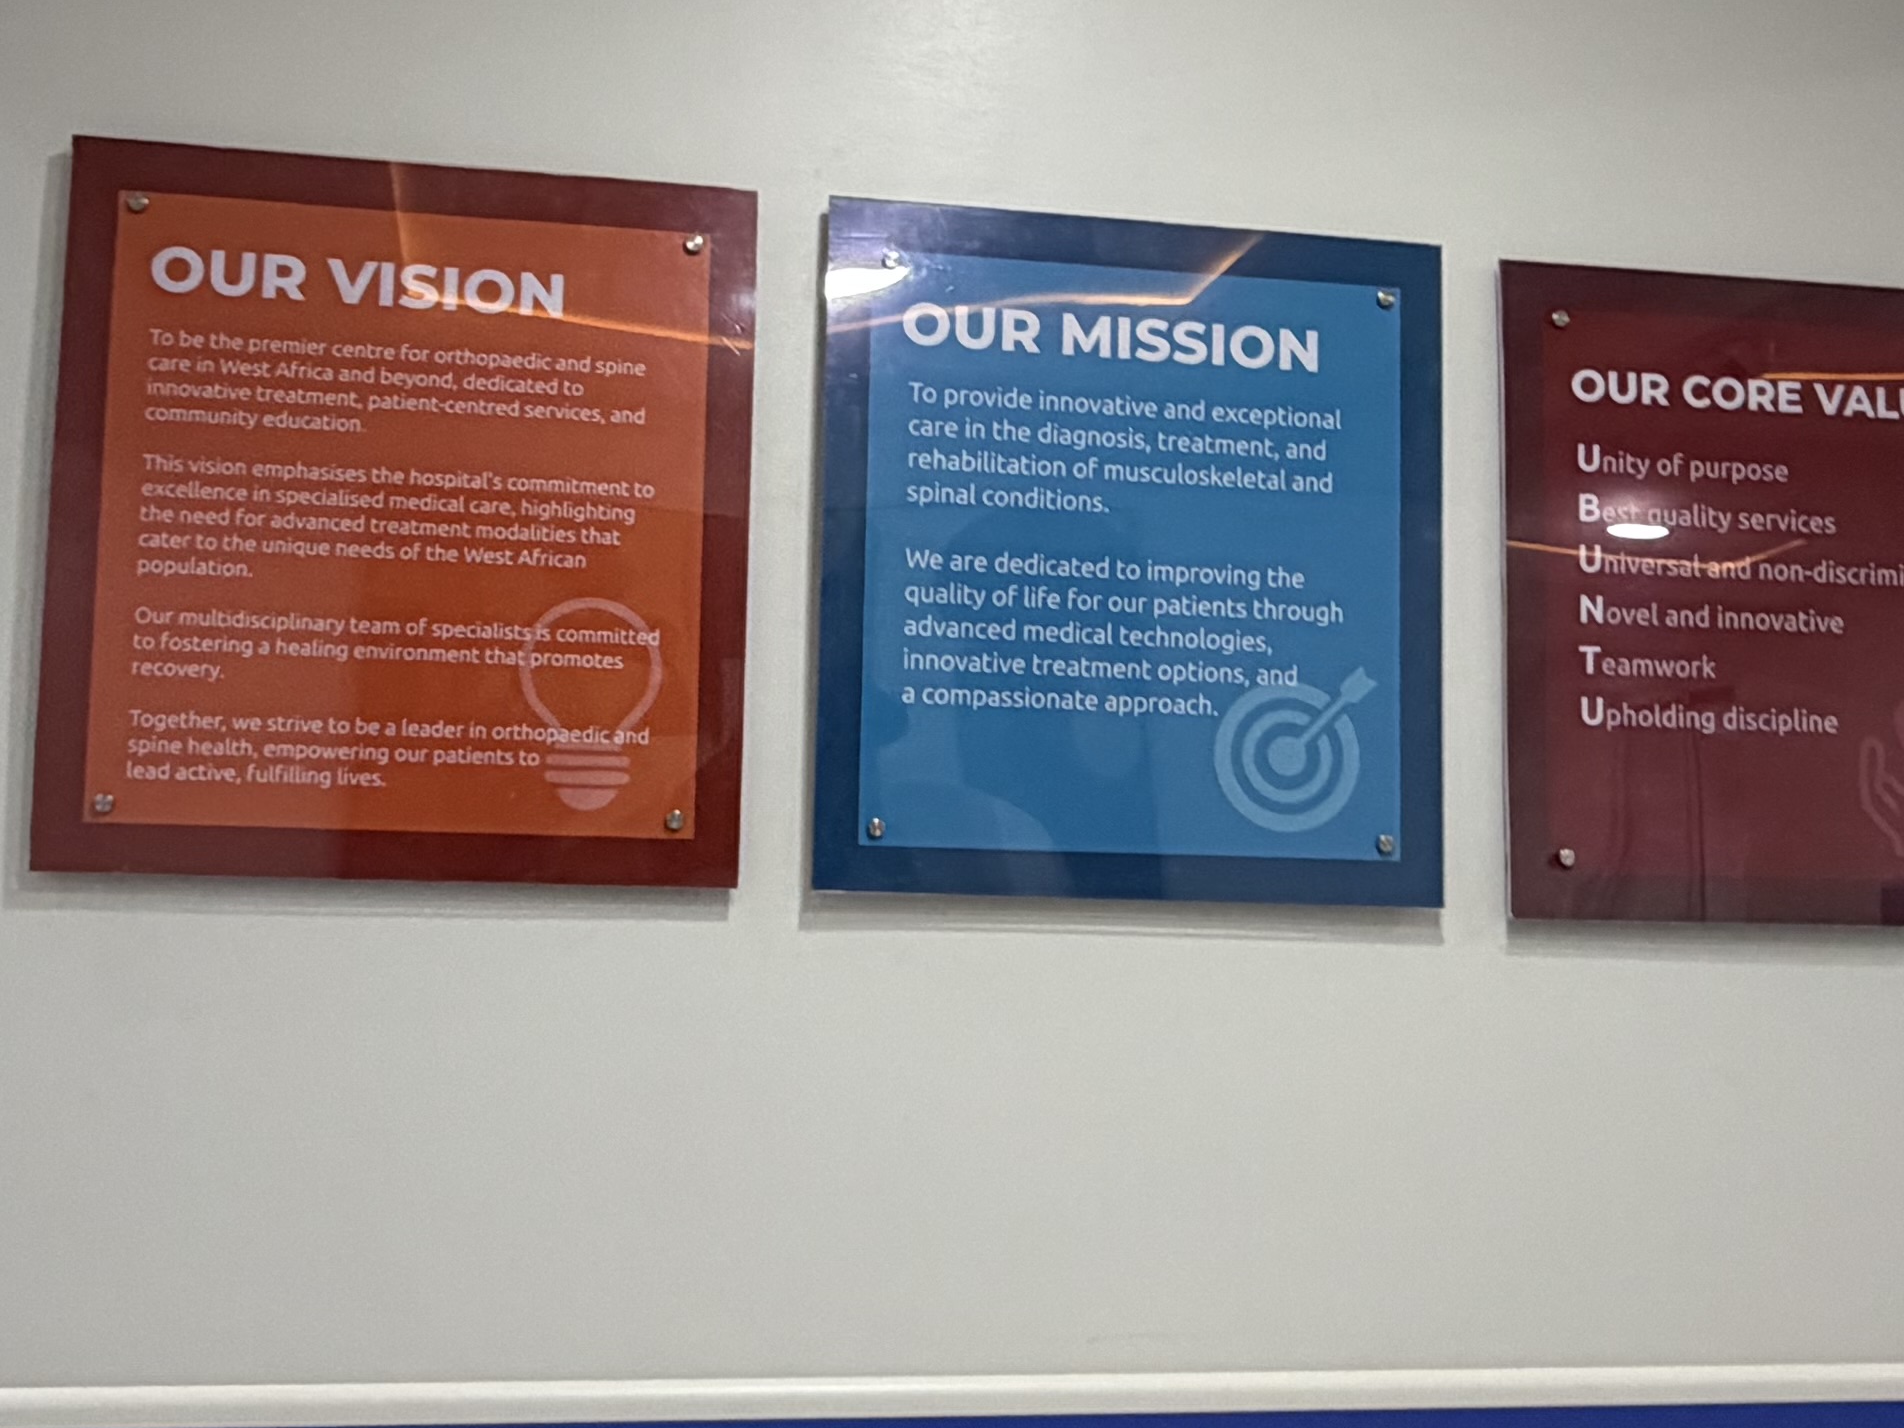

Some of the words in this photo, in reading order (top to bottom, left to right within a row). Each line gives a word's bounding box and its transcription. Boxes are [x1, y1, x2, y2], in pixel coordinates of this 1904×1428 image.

[149, 244, 307, 301] OUR
[324, 256, 566, 319] VISION
[148, 327, 175, 346] To
[178, 328, 205, 348] be
[208, 331, 244, 351] the
[247, 337, 327, 356] premier
[331, 342, 396, 360] centre
[399, 342, 430, 362] for
[433, 347, 552, 371] orthopaedic
[554, 354, 591, 373] and
[594, 358, 646, 378] spine
[902, 300, 1040, 354] OUR
[1061, 311, 1319, 373] MISSION
[147, 356, 191, 372] care
[196, 356, 215, 374] in
[218, 357, 271, 377] West
[274, 360, 334, 381] Africa
[337, 365, 375, 384] and
[379, 366, 458, 392] beyond,
[462, 371, 558, 395] dedicated
[562, 379, 584, 396] to
[1570, 366, 1670, 406] OUR
[1681, 373, 1803, 414] CORE
[144, 406, 258, 431] community
[145, 378, 252, 401] innovative
[255, 385, 363, 411] treatment,
[367, 393, 521, 417] patient-centred
[523, 403, 605, 425] services,
[610, 406, 646, 424] and
[908, 381, 937, 404] To
[943, 387, 1032, 411] provide
[1039, 391, 1158, 418] innovative
[1163, 398, 1205, 421] and
[1211, 405, 1341, 430] exceptional
[907, 419, 958, 438] care
[964, 419, 986, 440] in
[992, 419, 1031, 443] the
[1037, 421, 1151, 453] diagnosis,
[1157, 431, 1279, 460] treatment,
[1285, 438, 1326, 460] and
[141, 453, 184, 473] This
[187, 457, 247, 476] vision
[251, 460, 367, 483] emphasises
[370, 465, 405, 484] the
[408, 466, 503, 491] hospital's
[506, 476, 630, 496] commitment
[633, 481, 655, 498] to
[906, 448, 1067, 477] rehabilitation
[1072, 457, 1099, 479] of
[1103, 462, 1286, 490] musculoskeletal
[1291, 471, 1333, 493] and
[1575, 442, 1651, 480] Unity
[1656, 452, 1684, 477] of
[1689, 460, 1789, 486] purpose
[140, 480, 248, 501] excellence
[252, 485, 271, 502] in
[275, 488, 385, 508] specialised
[388, 492, 465, 512] medical
[468, 499, 516, 518] care,
[520, 497, 635, 525] highlighting
[906, 483, 976, 508] spinal
[981, 486, 1110, 512] conditions.
[1576, 493, 1645, 525] Best
[1649, 504, 1732, 535] quality
[1737, 511, 1837, 535] services
[139, 503, 174, 523] the
[179, 506, 230, 526] need
[234, 507, 266, 527] for
[270, 510, 366, 532] advanced
[369, 516, 471, 538] treatment
[475, 521, 577, 543] modalities
[580, 525, 621, 545] that
[136, 556, 253, 578] population.
[137, 531, 191, 549] cater
[194, 533, 218, 550] to
[221, 532, 257, 552] the
[261, 537, 330, 559] unique
[335, 539, 395, 559] needs
[398, 541, 421, 560] of
[425, 542, 459, 562] the
[463, 545, 514, 564] West
[517, 547, 587, 568] African
[904, 547, 944, 570] We
[949, 553, 987, 572] are
[994, 550, 1110, 578] dedicated
[1116, 559, 1141, 580] to
[1147, 560, 1260, 591] improving
[1267, 565, 1305, 588] the
[1577, 543, 1700, 577] Universal
[1707, 555, 1752, 580] and
[904, 581, 986, 610] quality
[991, 584, 1018, 606] of
[1023, 585, 1061, 608] life
[1067, 587, 1102, 610] for
[1107, 594, 1147, 613] our
[1153, 595, 1247, 619] patients
[1252, 597, 1343, 627] through
[1578, 594, 1658, 626] Novel
[1664, 604, 1710, 628] and
[1717, 607, 1844, 634] innovative
[133, 605, 173, 625] Our
[177, 608, 345, 636] multidisciplinary
[348, 615, 401, 634] team
[405, 616, 427, 635] of
[431, 620, 532, 641] specialists
[535, 623, 552, 641] is
[555, 626, 660, 645] committed
[903, 613, 1016, 639] advanced
[1022, 620, 1113, 644] medical
[1119, 624, 1272, 655] technologies,
[132, 632, 156, 650] to
[159, 631, 253, 658] fostering
[257, 639, 270, 654] a
[275, 636, 349, 662] healing
[352, 642, 480, 663] environment
[483, 645, 526, 664] that
[529, 650, 624, 669] promotes
[903, 648, 1026, 673] innovative
[1032, 653, 1152, 679] treatment
[1157, 660, 1249, 686] options,
[1256, 663, 1298, 685] and
[1578, 644, 1716, 679] Teamwork
[131, 660, 224, 682] recovery.
[902, 685, 915, 702] a
[922, 685, 1098, 710] compassionate
[1104, 692, 1218, 717] approach.
[1580, 696, 1716, 735] Upholding
[1722, 706, 1839, 738] discipline
[128, 708, 226, 732] Together,
[231, 715, 262, 731] we
[266, 714, 323, 733] strive
[327, 716, 351, 734] to
[354, 715, 381, 735] be
[384, 720, 397, 735] a
[401, 717, 464, 737] leader
[468, 721, 487, 738] in
[491, 721, 610, 745] orthopaedic
[612, 725, 649, 744] and
[127, 736, 183, 757] spine
[186, 735, 258, 759] health,
[262, 742, 390, 765] empowering
[393, 746, 428, 761] our
[432, 746, 515, 766] patients
[518, 748, 540, 765] to
[125, 759, 171, 779] lead
[174, 763, 241, 784] active,
[245, 762, 332, 788] fulfilling
[336, 765, 385, 786] lives.
